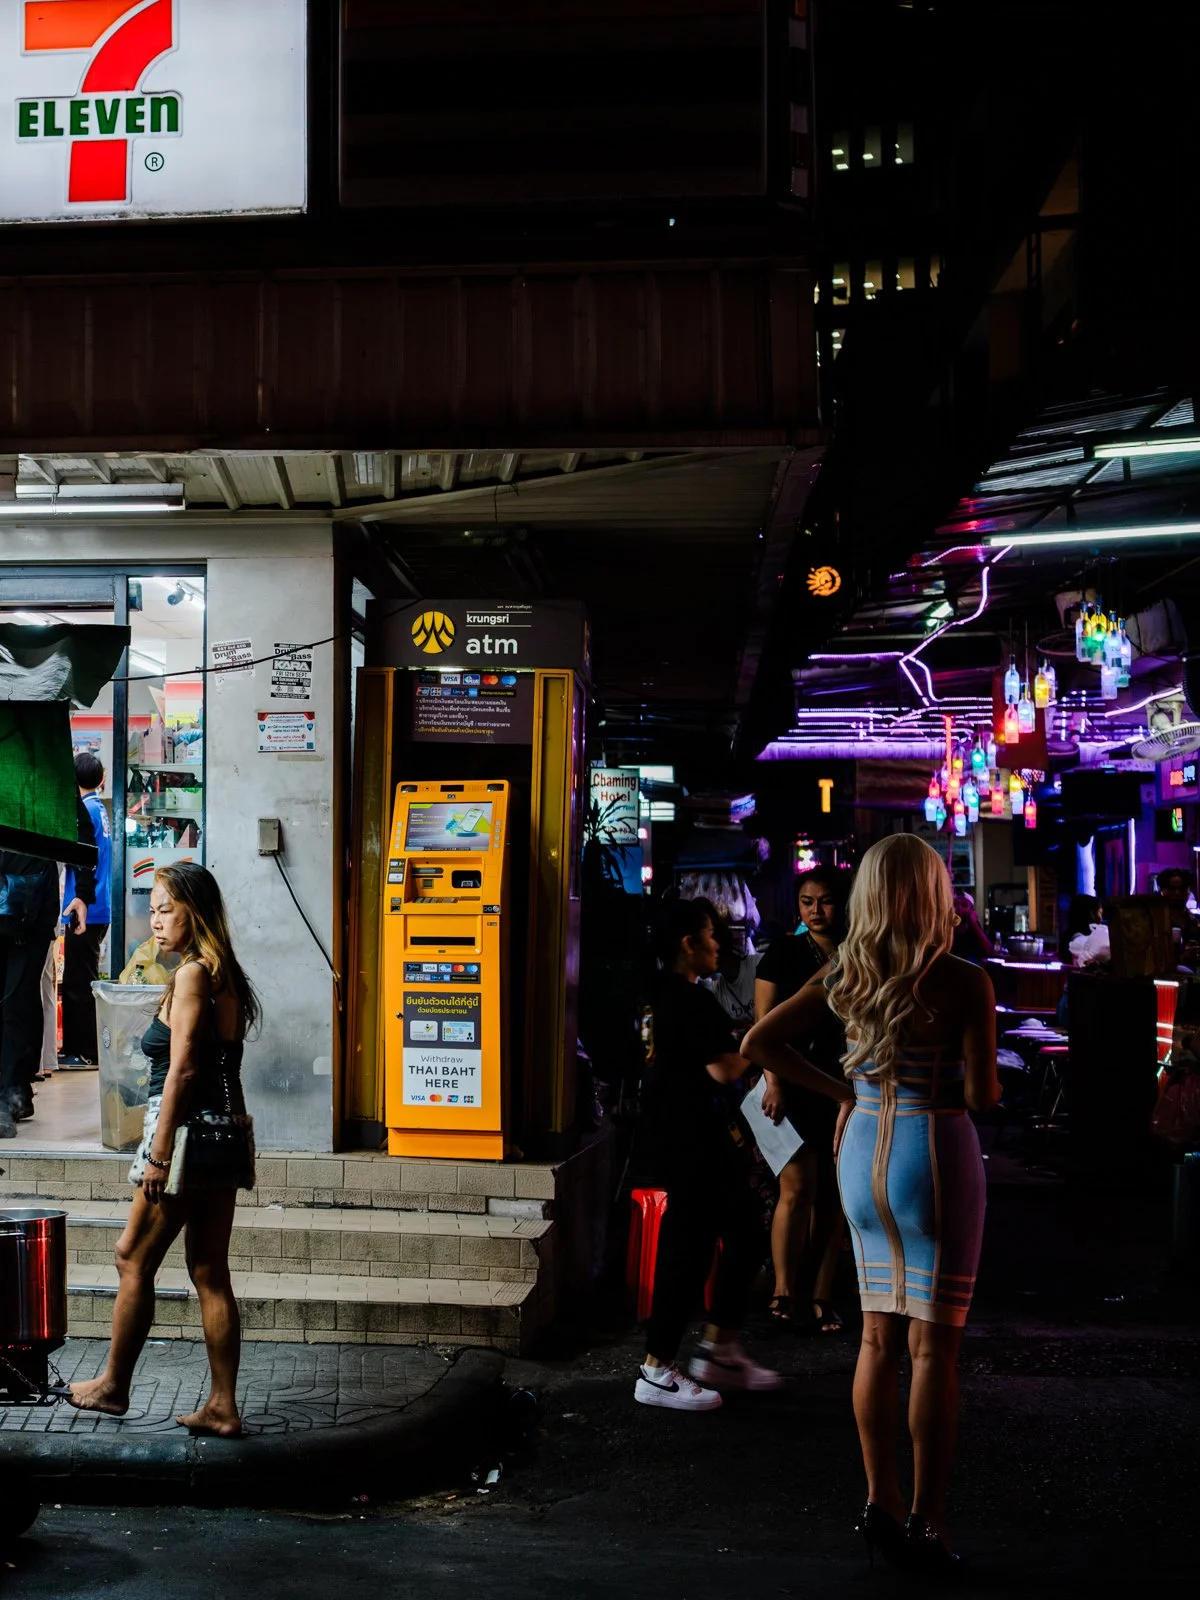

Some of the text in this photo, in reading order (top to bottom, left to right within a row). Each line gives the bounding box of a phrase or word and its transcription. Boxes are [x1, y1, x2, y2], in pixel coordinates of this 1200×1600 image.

[466, 613, 510, 625] krungsri
[465, 634, 518, 655] atm
[214, 649, 237, 660] Drum
[231, 652, 252, 662] Bass
[600, 791, 631, 802] Hotel
[420, 1055, 464, 1064] Withdraw
[408, 1065, 477, 1077] THAI BAHT
[425, 1078, 459, 1089] HERE
[410, 1094, 426, 1102] VISA
